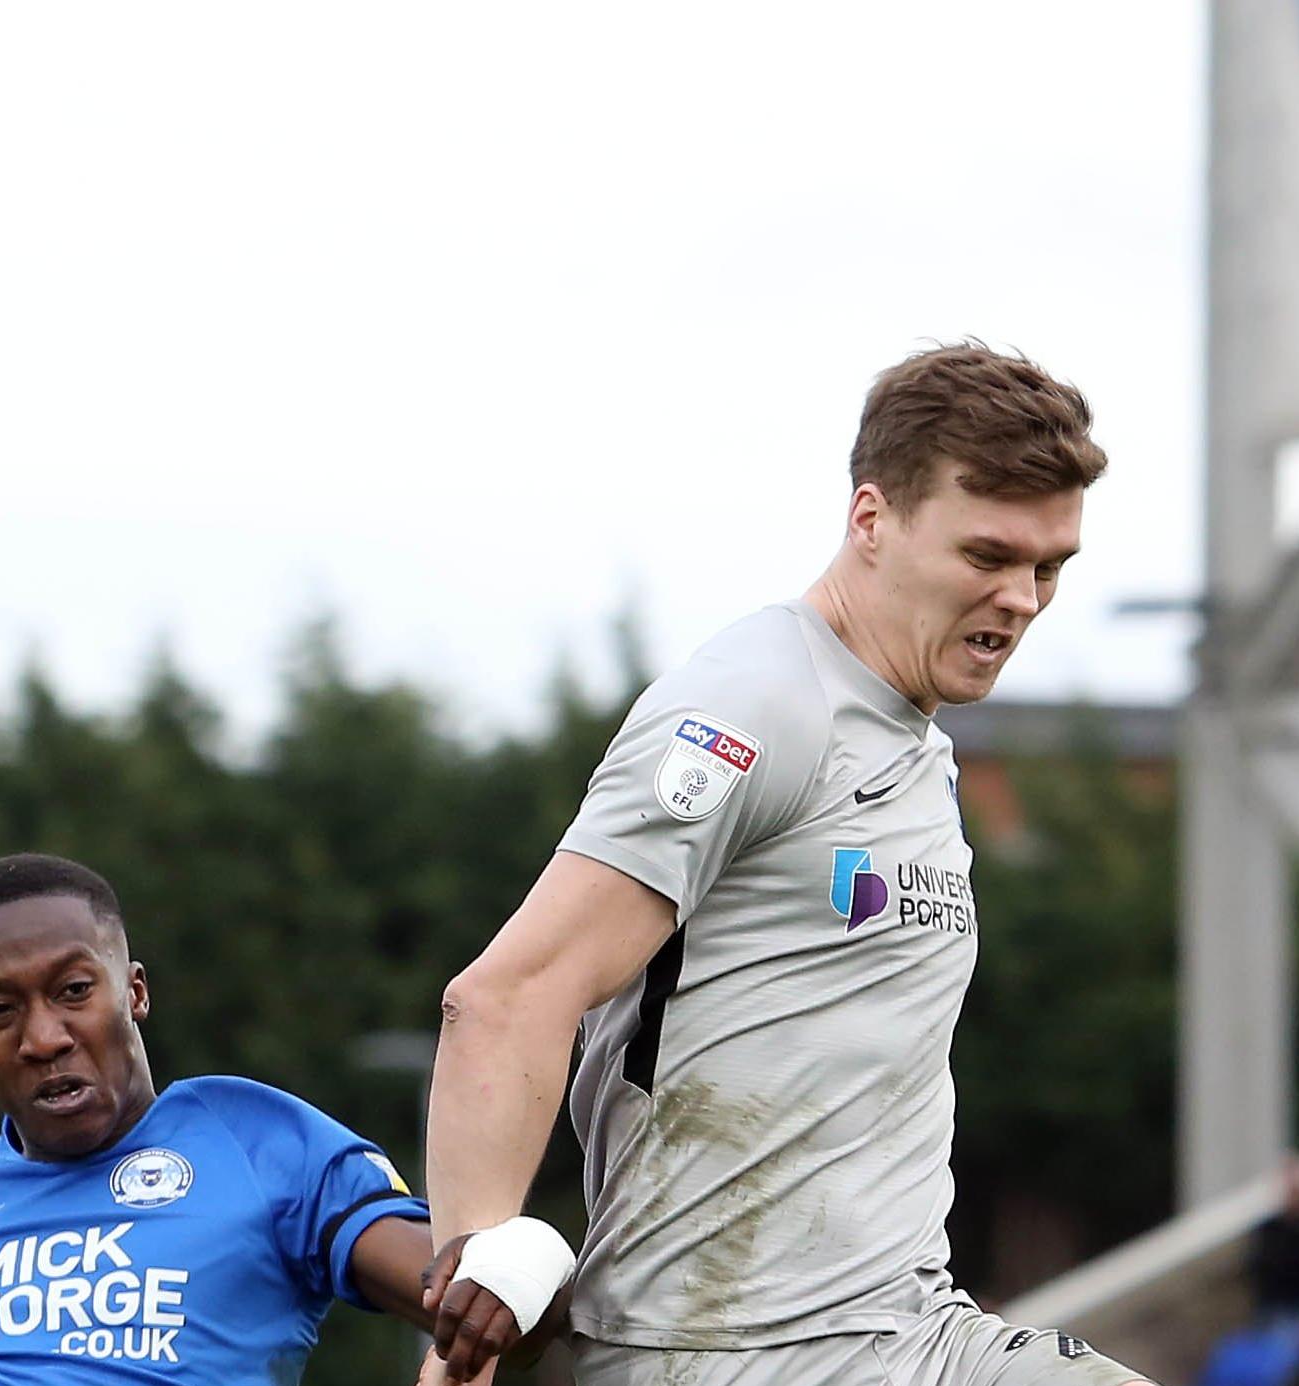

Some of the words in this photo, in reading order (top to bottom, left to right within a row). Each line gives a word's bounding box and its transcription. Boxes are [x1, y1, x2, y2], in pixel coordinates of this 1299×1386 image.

[678, 743, 715, 766] LEAGUE
[713, 759, 734, 777] ONE
[680, 723, 716, 746] sky
[715, 735, 752, 767] bet
[672, 791, 693, 812] EFL
[52, 1327, 180, 1362] .CO.UK
